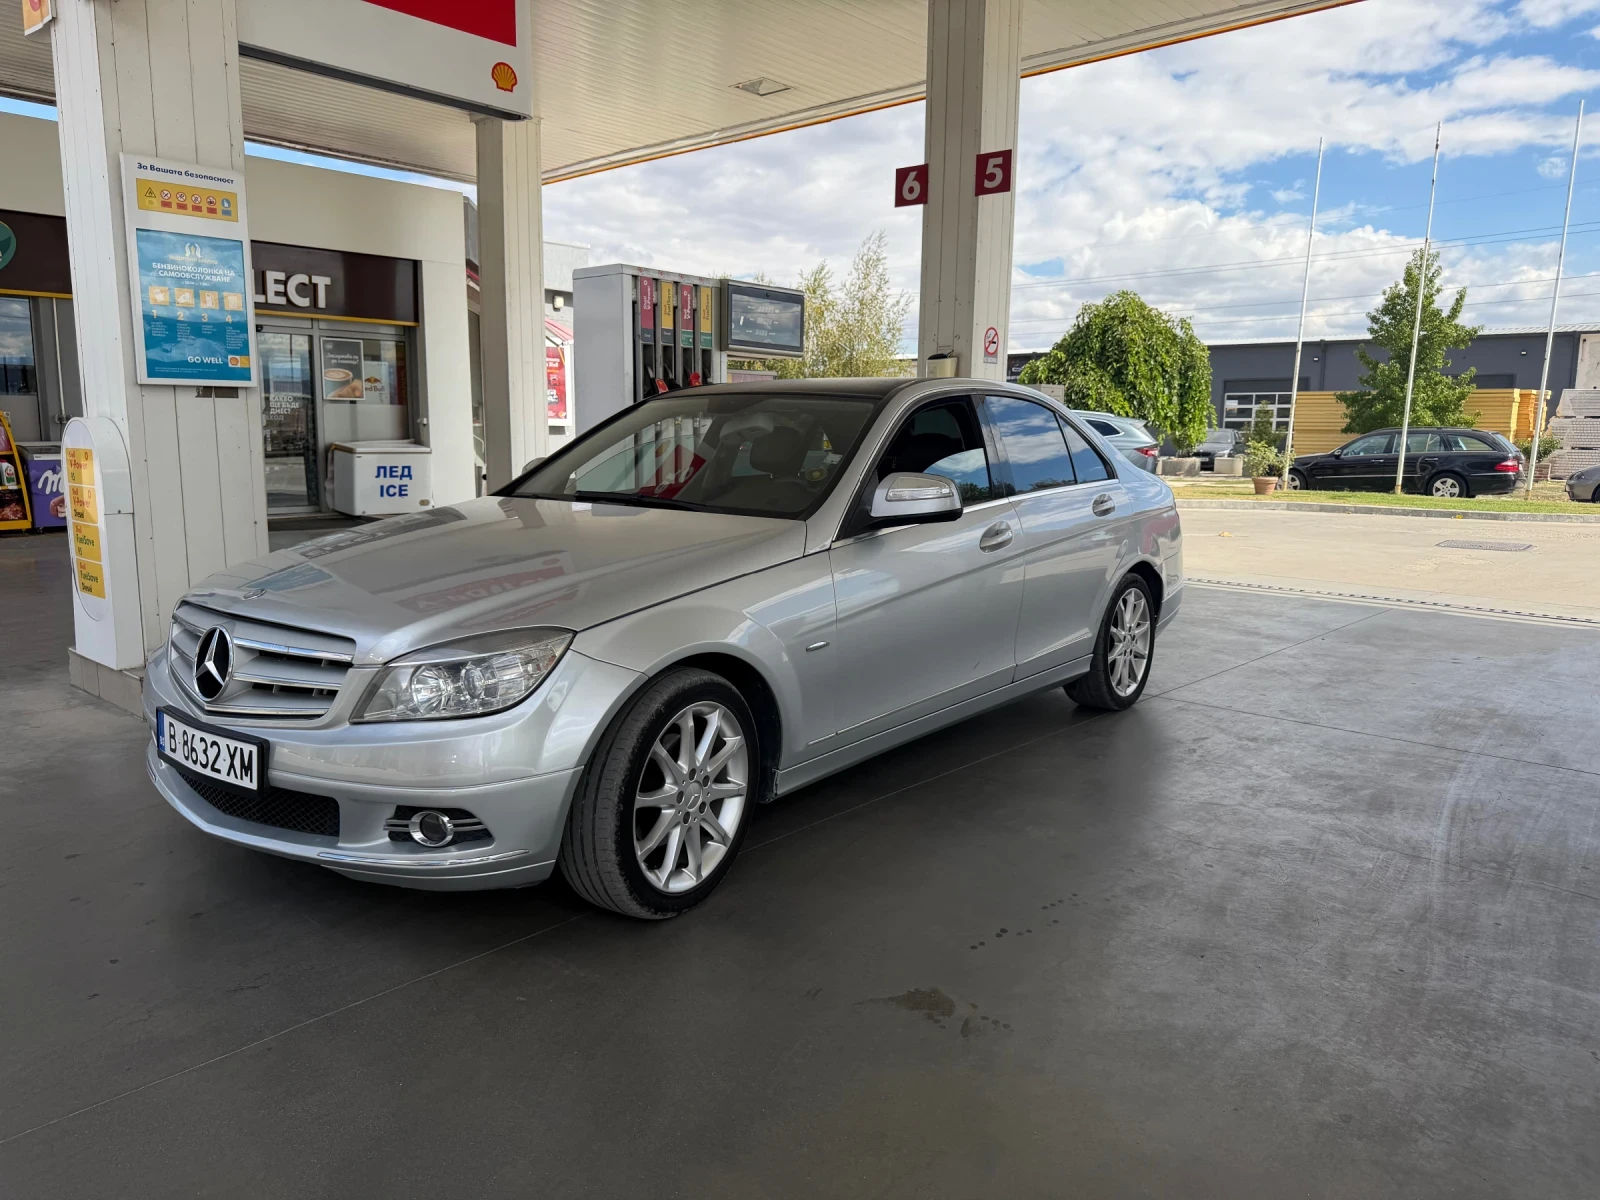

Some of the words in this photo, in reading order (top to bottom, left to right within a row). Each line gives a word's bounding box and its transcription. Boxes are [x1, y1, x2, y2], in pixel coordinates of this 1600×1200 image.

[149, 164, 182, 176] Вашата
[184, 170, 234, 184] безопасност
[984, 157, 1004, 188] 5
[902, 171, 920, 200] 6
[152, 262, 223, 276] БЕНЗИНОКОЛОНКА
[158, 270, 230, 282] САМООБСЛУЖВАНЕ
[252, 269, 331, 308] LECT
[152, 310, 157, 318] 1
[177, 312, 184, 320] 2
[202, 313, 208, 322] 3
[226, 315, 232, 324] 4
[70, 459, 88, 469] V-Power
[375, 466, 412, 480] ЛЕД
[380, 484, 408, 497] ICE
[73, 496, 90, 507] V-Power
[74, 509, 84, 518] Diesel
[76, 534, 94, 546] FuelSave
[80, 570, 98, 583] FuelSave
[82, 582, 92, 592] Diesel
[169, 721, 177, 754] B
[182, 729, 221, 774] 8632
[226, 744, 253, 784] XM
